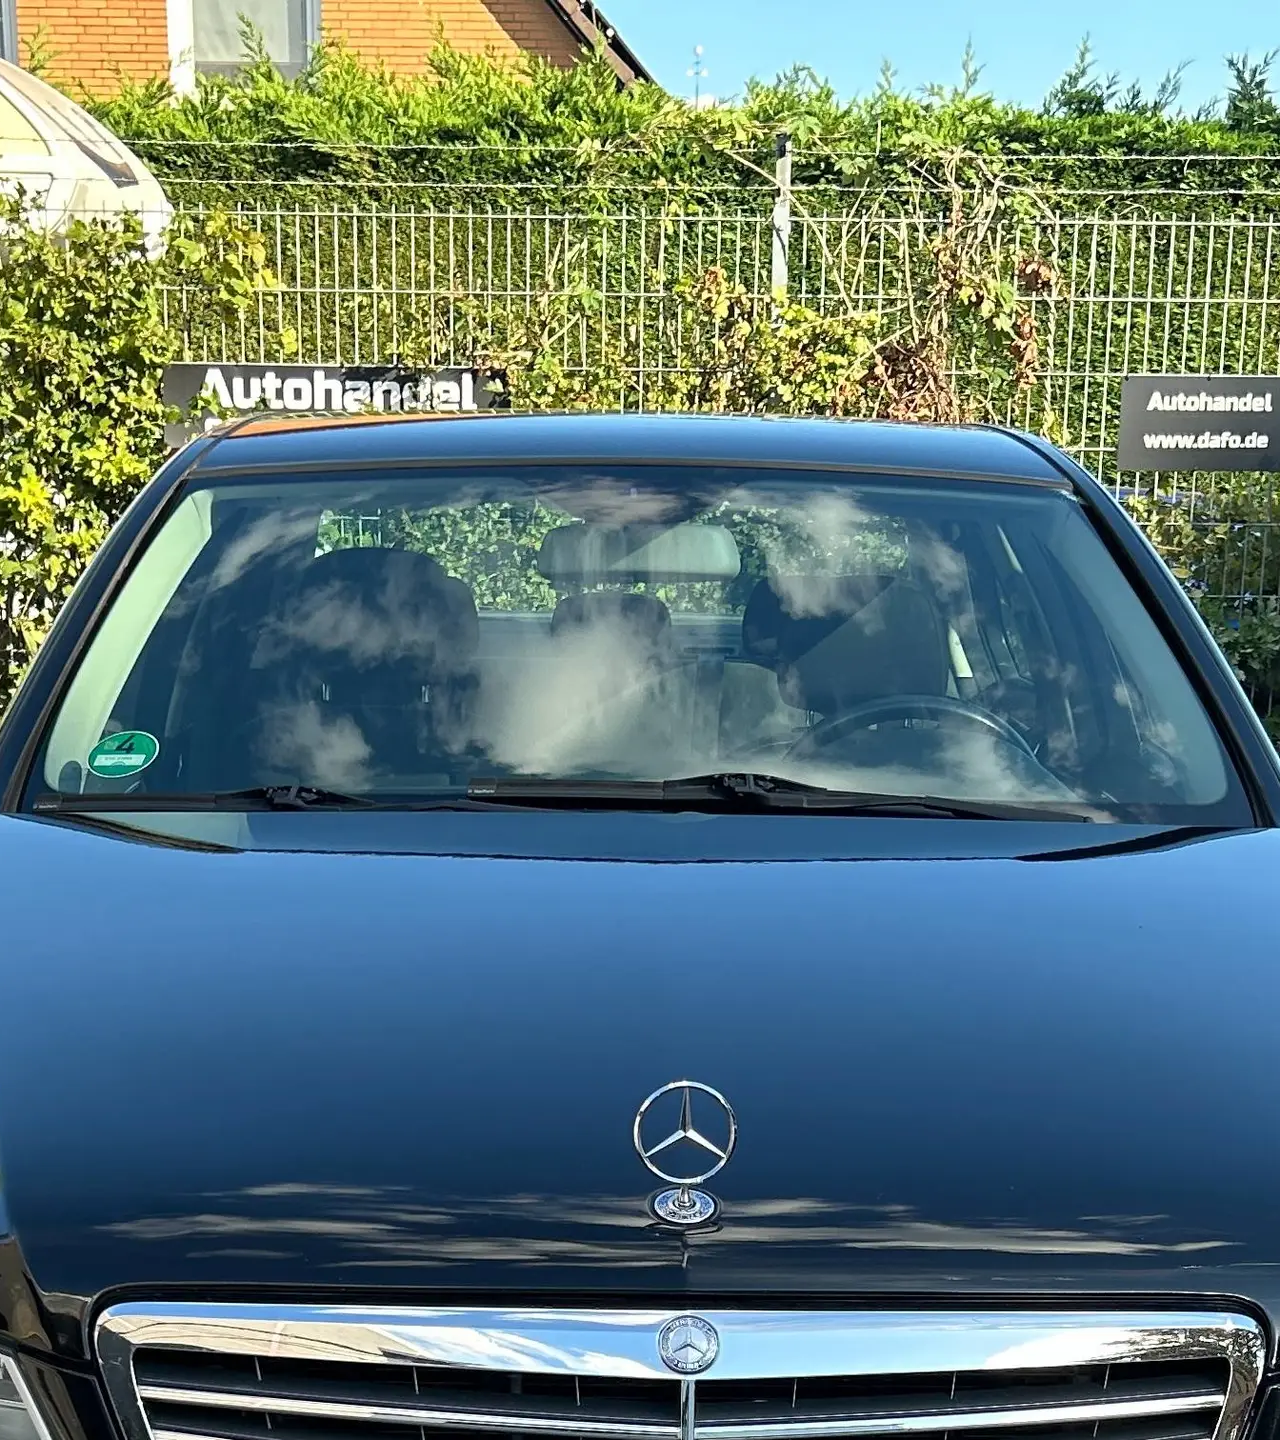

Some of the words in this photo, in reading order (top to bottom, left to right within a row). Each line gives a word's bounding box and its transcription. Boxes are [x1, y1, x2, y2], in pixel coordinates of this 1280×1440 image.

[200, 367, 478, 412] Autohandel
[1146, 390, 1273, 412] Autohandel
[1143, 431, 1269, 449] www.dafo.de
[115, 733, 136, 754] 4
